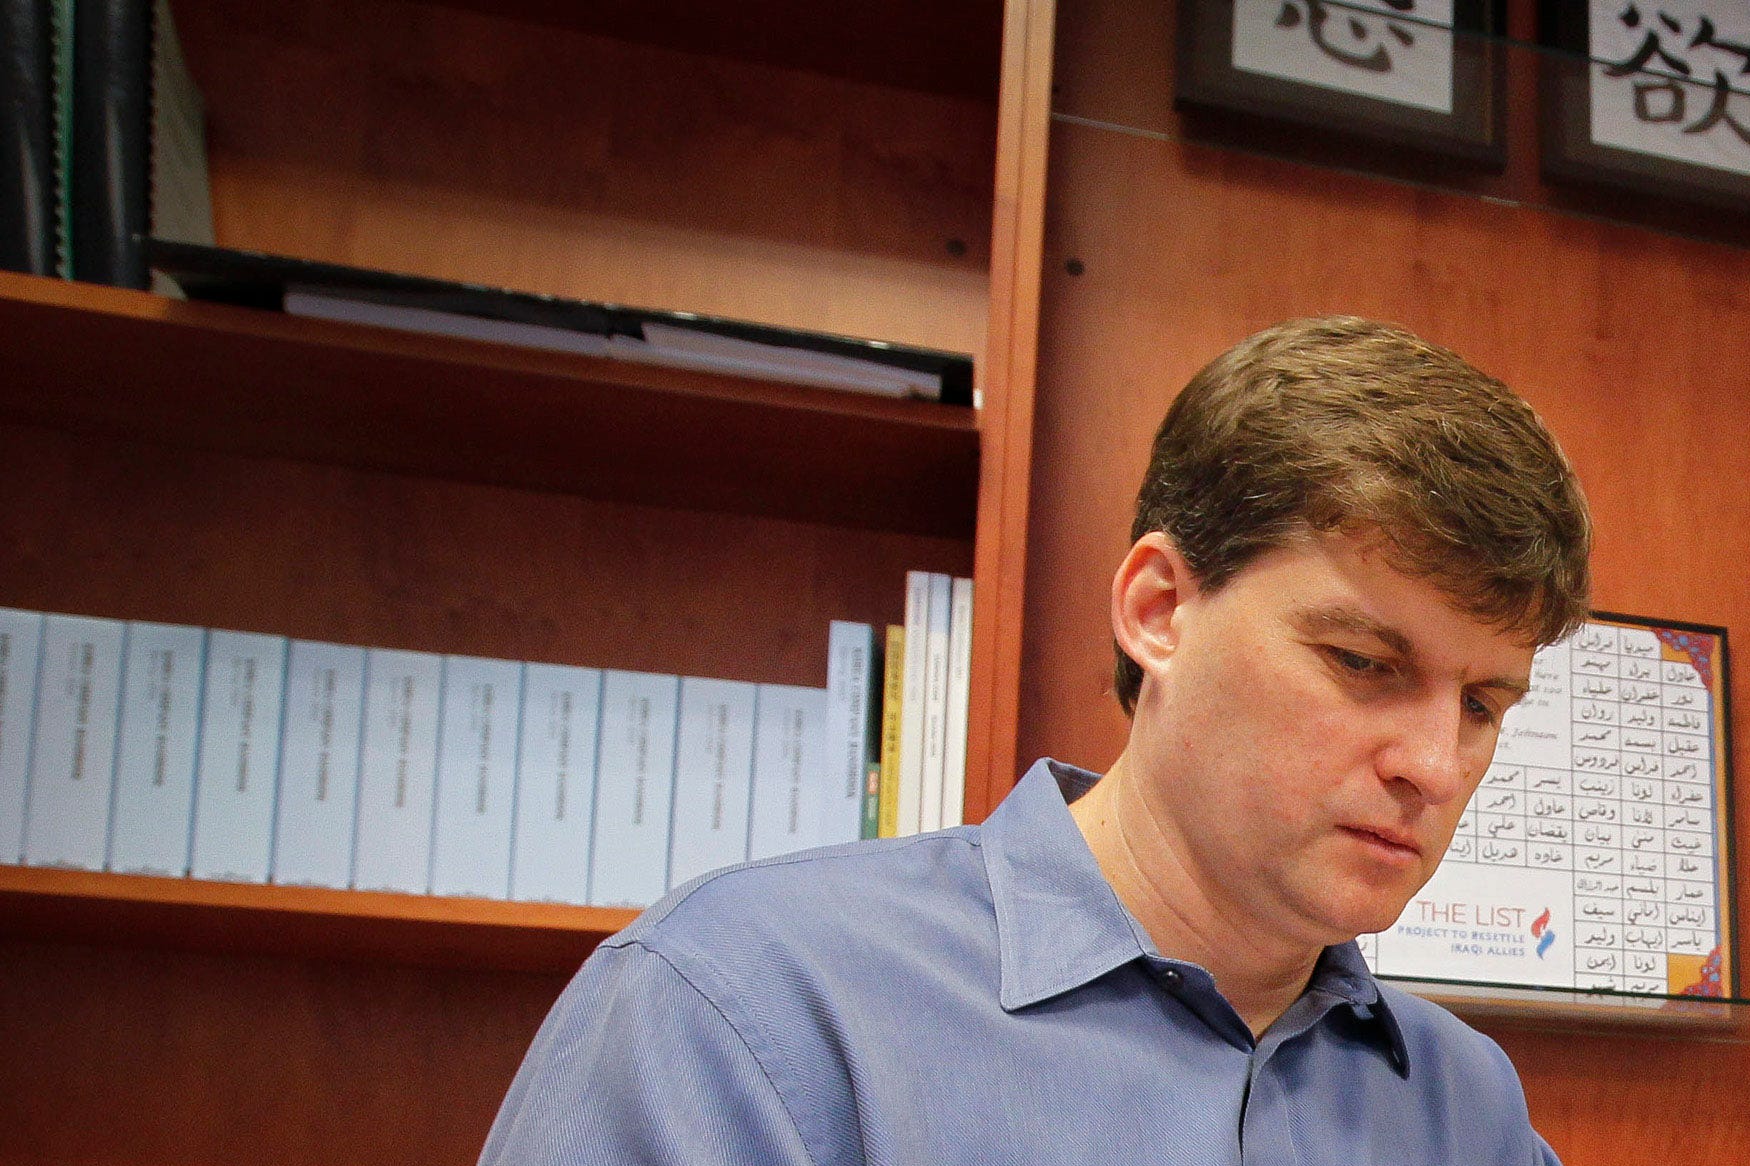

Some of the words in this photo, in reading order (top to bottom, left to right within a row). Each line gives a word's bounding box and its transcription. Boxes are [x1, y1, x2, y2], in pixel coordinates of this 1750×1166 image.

[1416, 900, 1466, 923] THE
[1476, 904, 1525, 927] LIST
[1398, 926, 1447, 938] PROJECT
[1452, 929, 1467, 939] TO
[1472, 931, 1525, 943] RESETTLE
[1451, 943, 1482, 956] IRAQI
[1487, 946, 1525, 956] ALLIES
